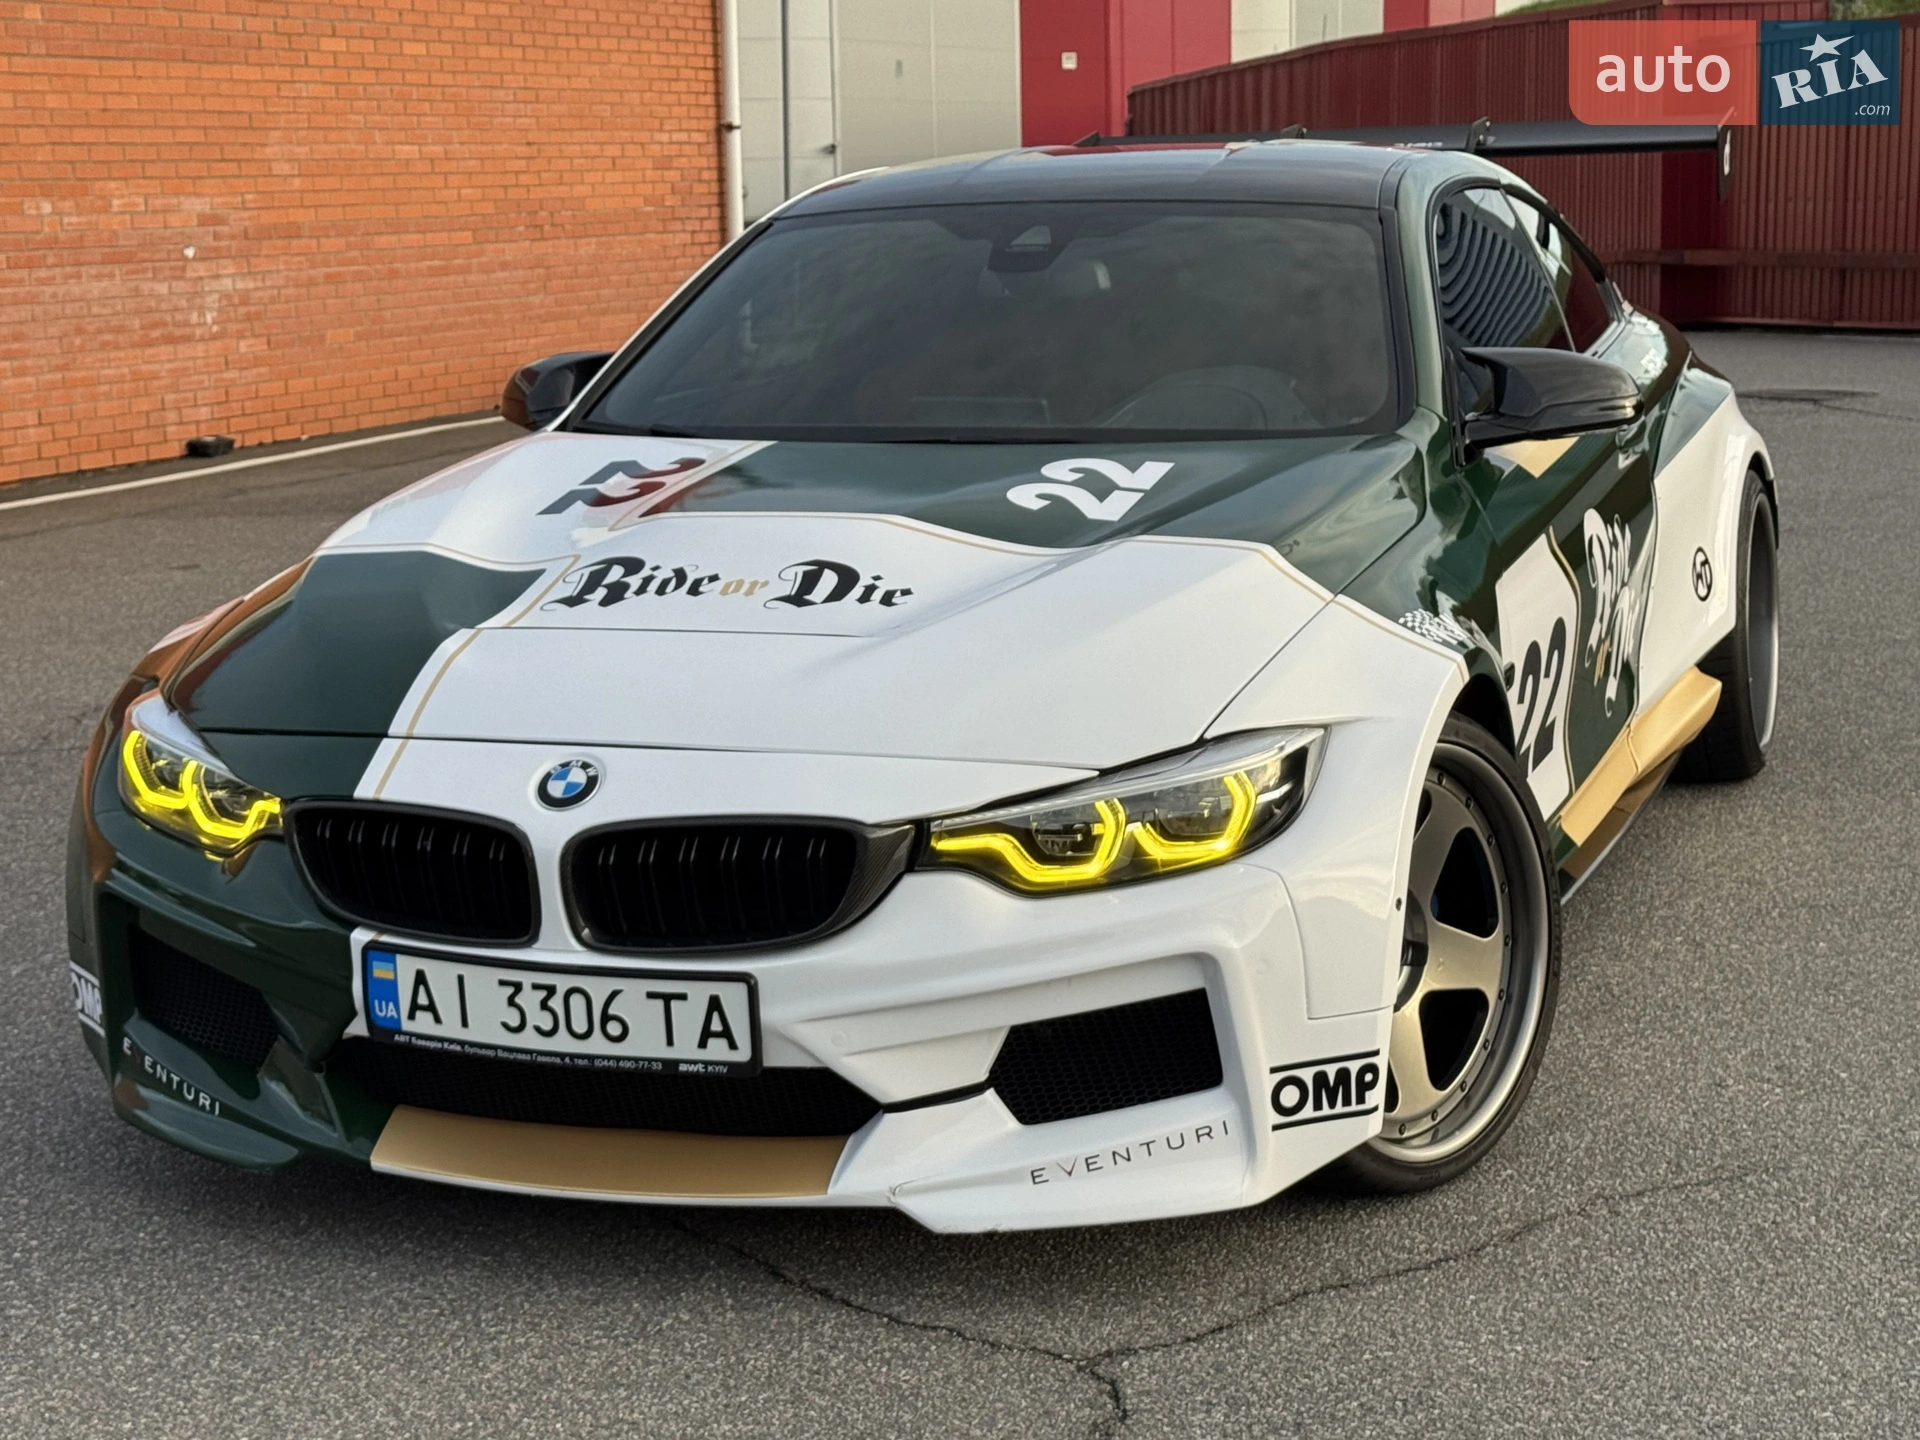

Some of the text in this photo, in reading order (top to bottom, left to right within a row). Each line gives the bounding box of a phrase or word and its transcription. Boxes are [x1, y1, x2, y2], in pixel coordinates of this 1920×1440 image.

[1006, 457, 1176, 522] 22
[540, 555, 915, 611] Ride or Die
[1515, 616, 1567, 780] 22
[375, 1000, 398, 1020] UA
[407, 968, 740, 1051] AI 3306 TA
[594, 1057, 618, 1068] (044)
[618, 1059, 663, 1070] 490-77-33
[1270, 1061, 1381, 1118] OMP
[1030, 1119, 1229, 1186] EVENTURI
